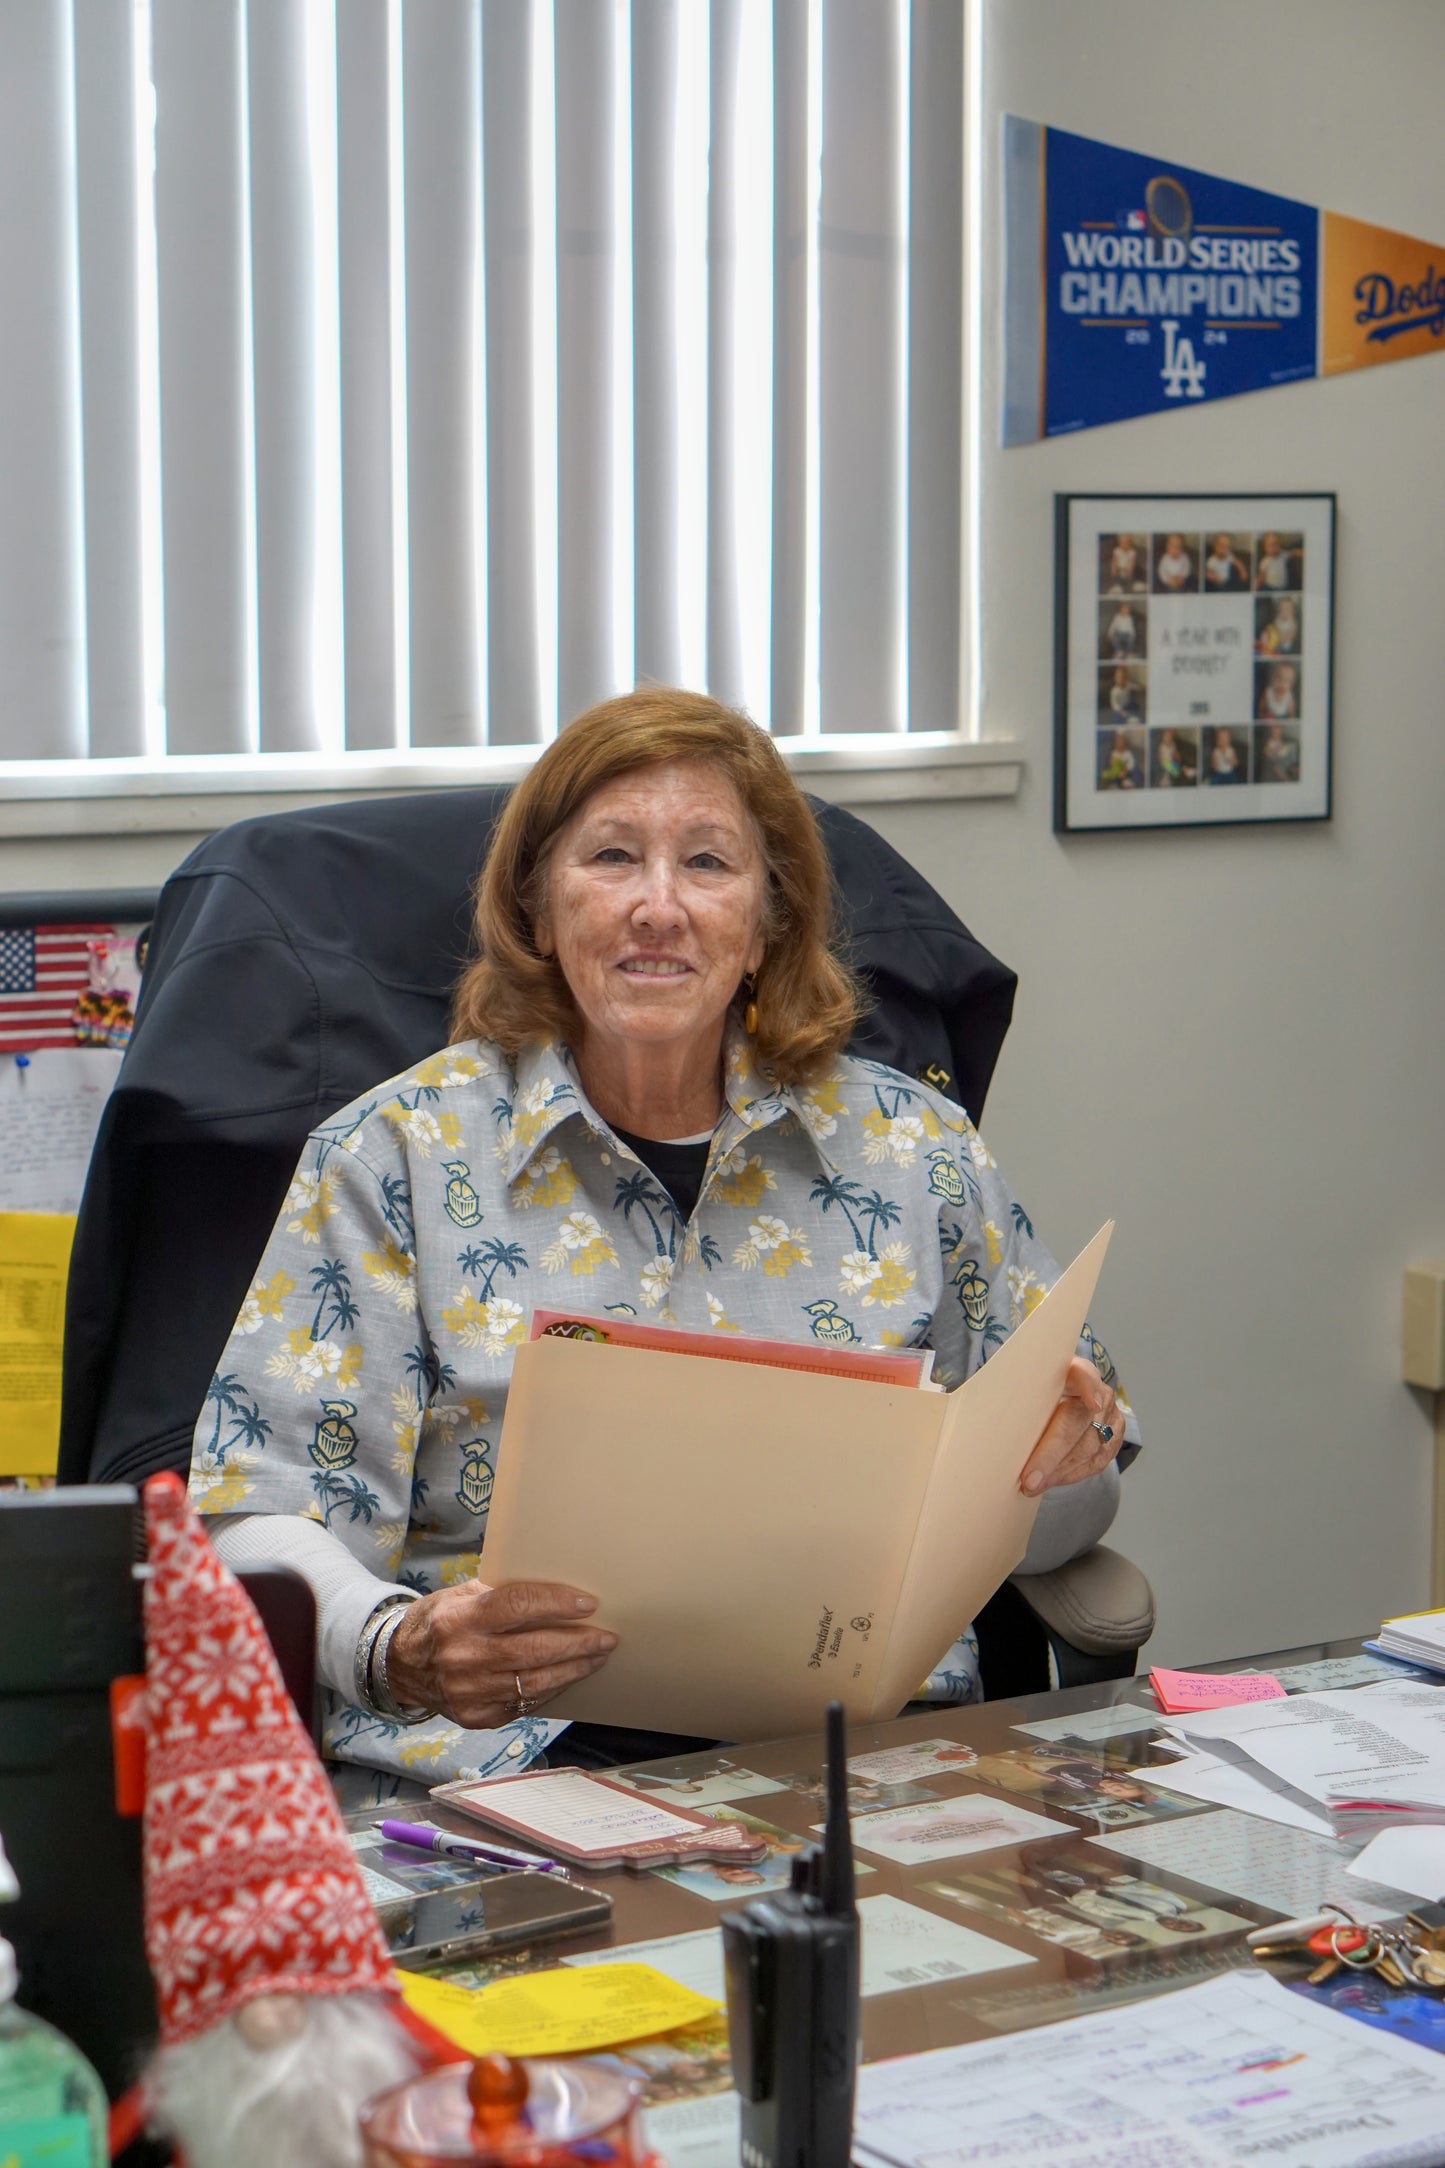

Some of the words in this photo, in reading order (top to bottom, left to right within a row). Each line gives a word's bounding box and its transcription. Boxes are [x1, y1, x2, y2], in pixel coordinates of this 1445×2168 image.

[1062, 232, 1187, 269] WORLD
[1189, 236, 1301, 274] SERIES
[1060, 271, 1301, 318] CHAMPIONS
[1125, 328, 1151, 345] 20
[1203, 329, 1228, 346] 24
[1160, 319, 1206, 398] LA
[811, 1604, 834, 1662] Pendaflex
[831, 1626, 844, 1653] Esselte
